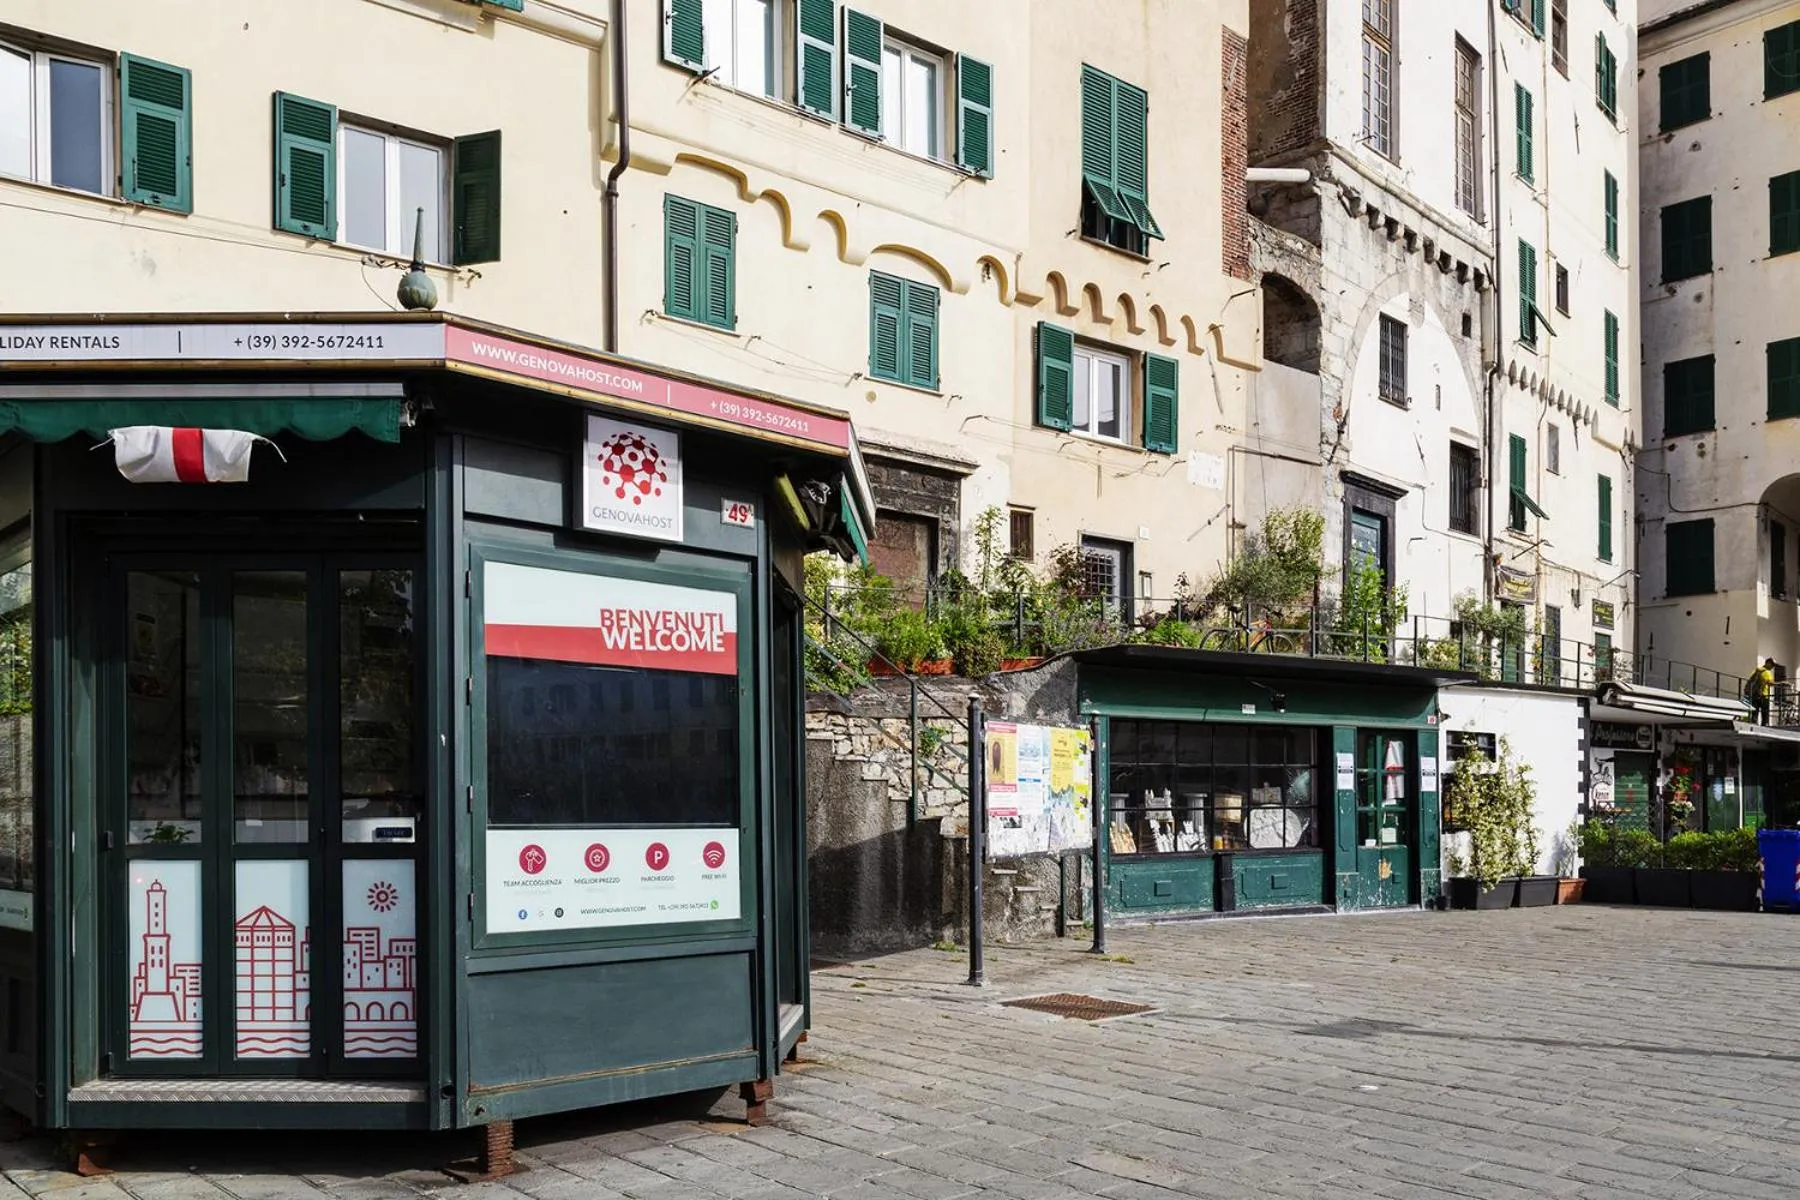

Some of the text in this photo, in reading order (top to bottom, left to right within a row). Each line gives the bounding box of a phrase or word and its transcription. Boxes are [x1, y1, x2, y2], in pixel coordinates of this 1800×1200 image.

[49, 336, 120, 349] RENTALS
[246, 335, 277, 350] (39)
[281, 335, 384, 349] 392-5672411
[472, 341, 643, 393] WWW.GENOVAHOST.COM
[719, 400, 741, 418] (39)
[742, 407, 810, 433] 392-5672411
[592, 506, 673, 529] GENOVAHOST
[600, 608, 724, 632] BENVENUTI
[601, 626, 725, 652] WELCOME
